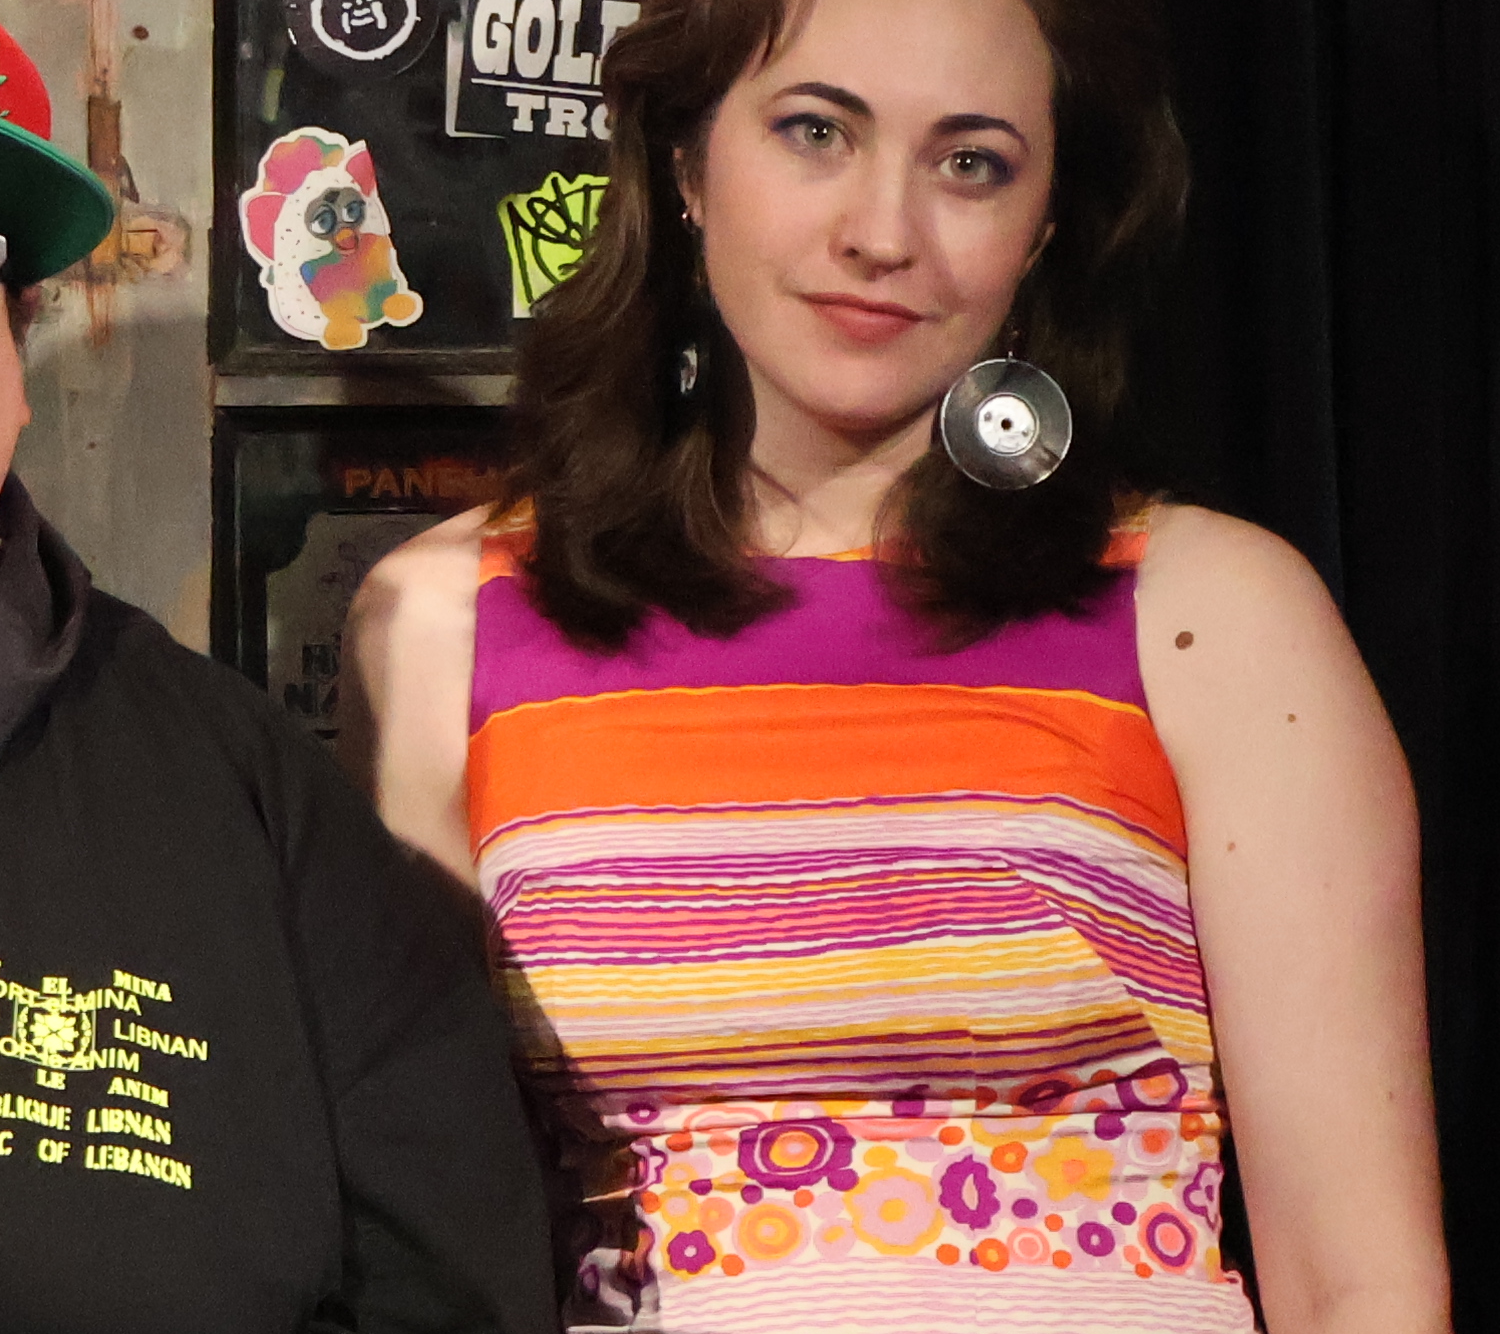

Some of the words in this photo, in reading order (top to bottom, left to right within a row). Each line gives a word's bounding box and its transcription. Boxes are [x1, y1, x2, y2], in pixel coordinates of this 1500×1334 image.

[42, 977, 72, 994] EL
[113, 969, 172, 1002] MINA
[114, 1019, 208, 1061] LIBNAN
[36, 1069, 66, 1090] LE
[107, 1076, 169, 1108] ANIM
[86, 1108, 172, 1145] LIBNAN
[38, 1138, 71, 1164] OF
[85, 1145, 192, 1189] LEBANON
